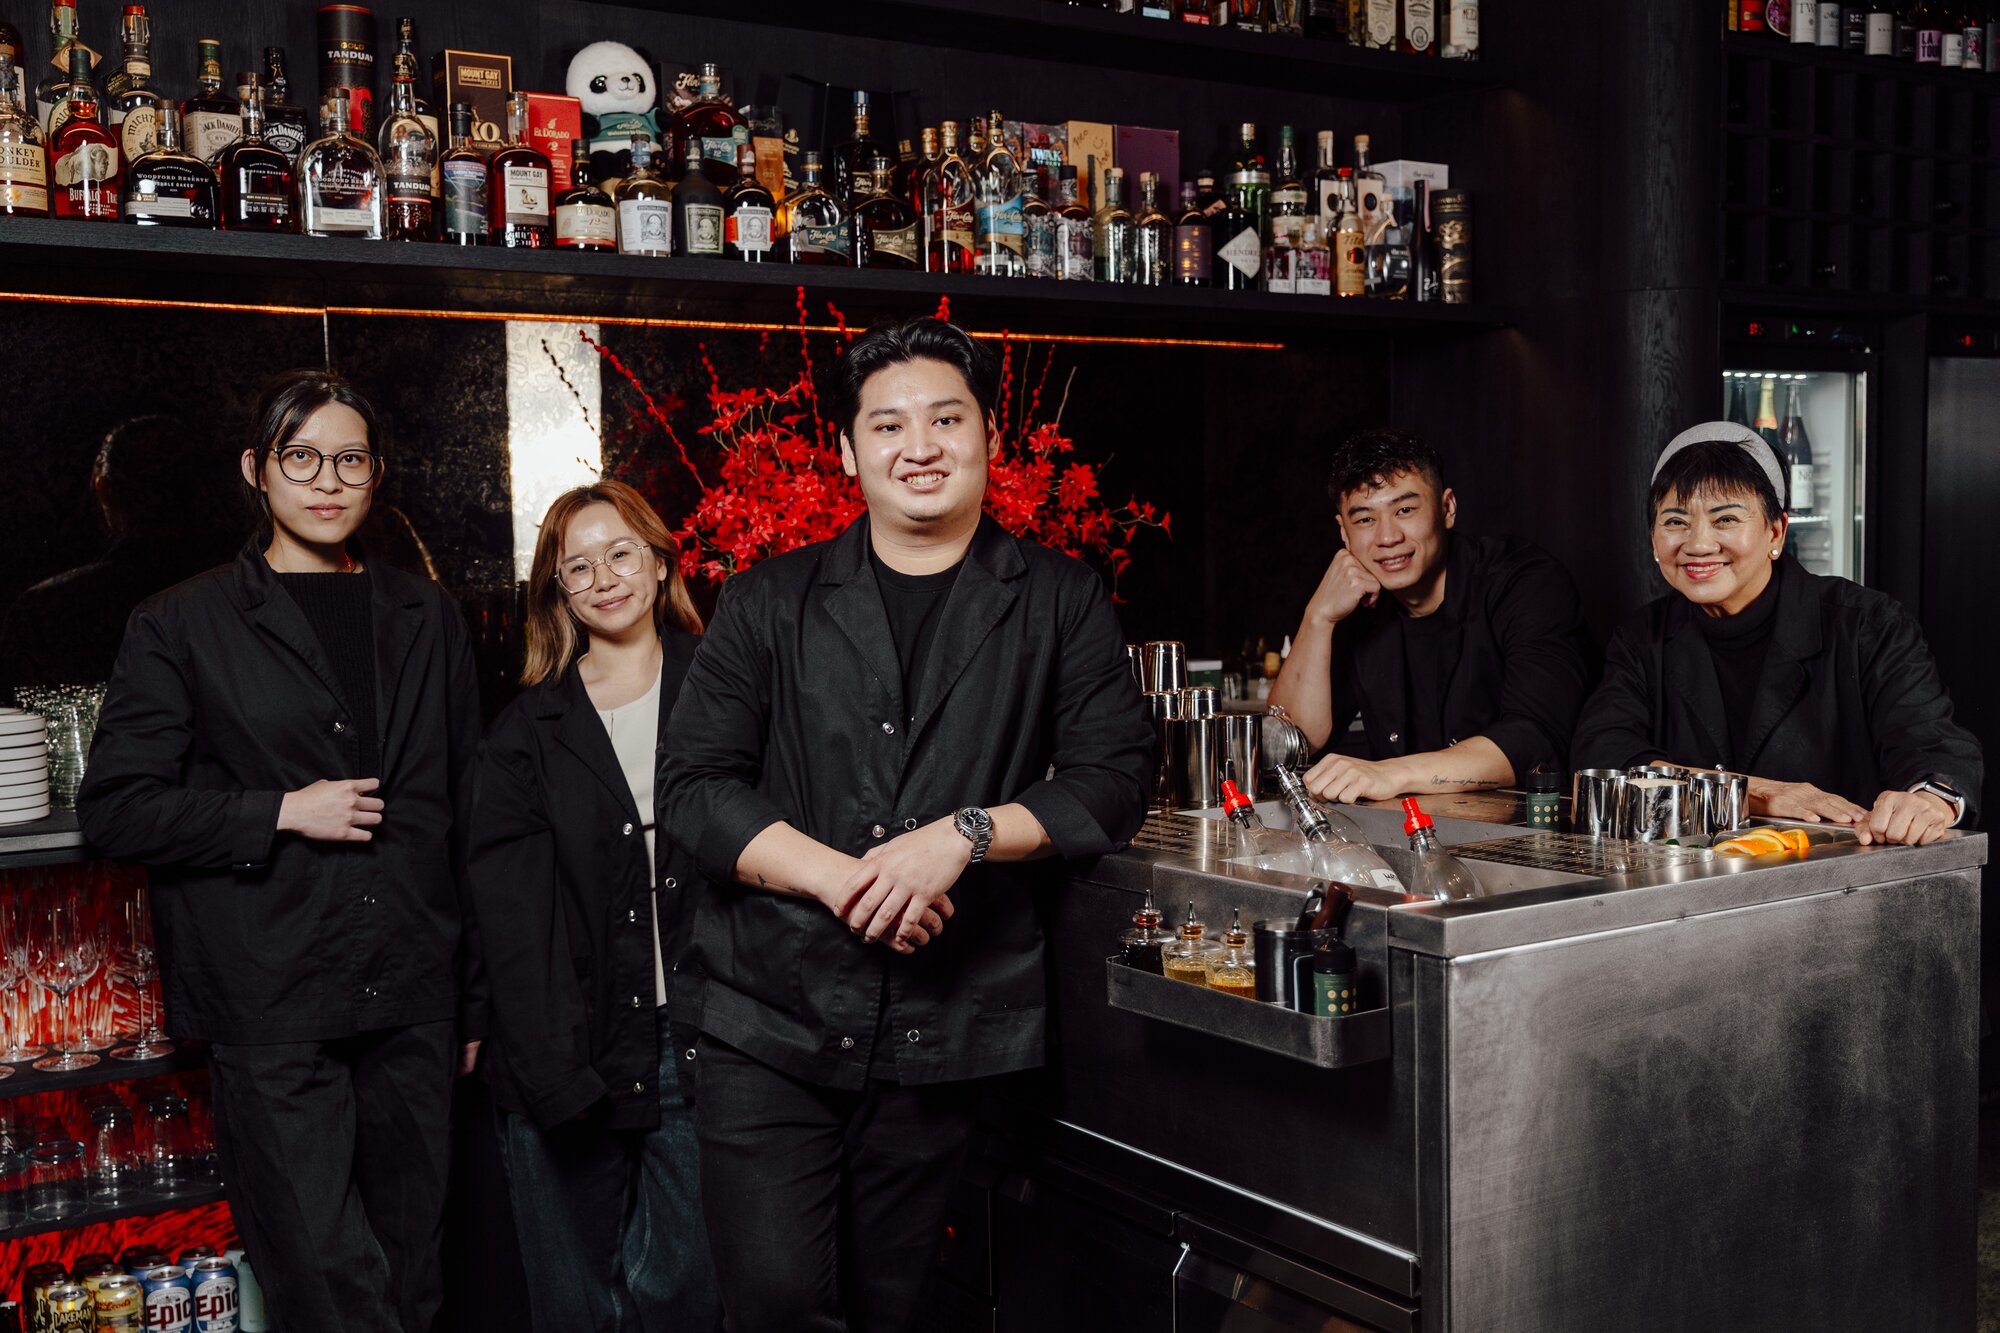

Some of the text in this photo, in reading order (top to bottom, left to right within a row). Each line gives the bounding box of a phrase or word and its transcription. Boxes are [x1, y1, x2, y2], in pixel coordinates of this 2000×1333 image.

[341, 41, 365, 50] GOLD
[327, 50, 373, 62] TANDUAY
[461, 69, 498, 80] MOUNT GAY
[202, 120, 216, 133] JACK
[543, 128, 570, 139] DORADO
[0, 146, 36, 158] ONKEY
[0, 156, 41, 168] OULDER
[137, 173, 176, 181] WOODFORD
[510, 169, 531, 177] MOUNT
[393, 181, 430, 192] TANDUA
[69, 187, 101, 202] BUFALO
[195, 1286, 239, 1320] Epic
[54, 1306, 93, 1322] LAKEMAN
[146, 1297, 192, 1330] Epic
